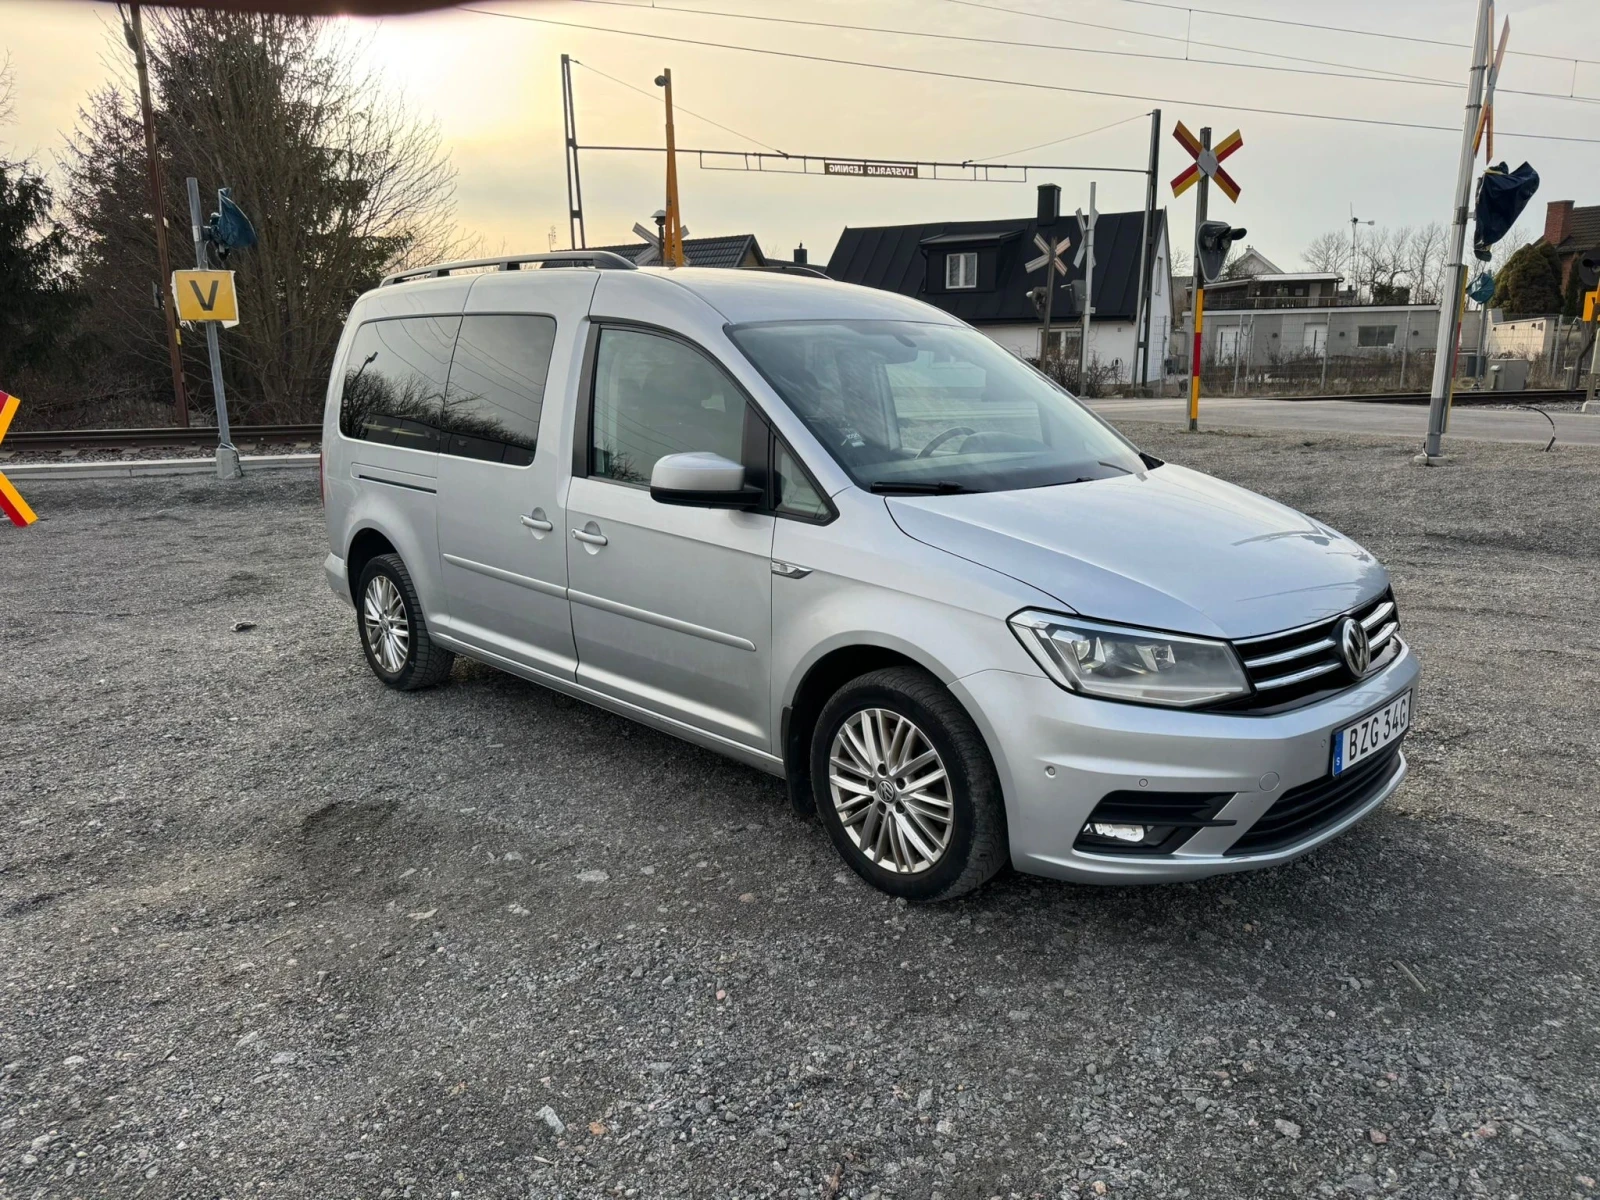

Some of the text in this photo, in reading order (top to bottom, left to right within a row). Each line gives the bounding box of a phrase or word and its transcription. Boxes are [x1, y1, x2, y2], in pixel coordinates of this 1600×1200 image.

[189, 280, 219, 311] V
[1343, 619, 1370, 677] VW
[1349, 699, 1406, 761] BZG 34G
[1336, 757, 1340, 766] S
